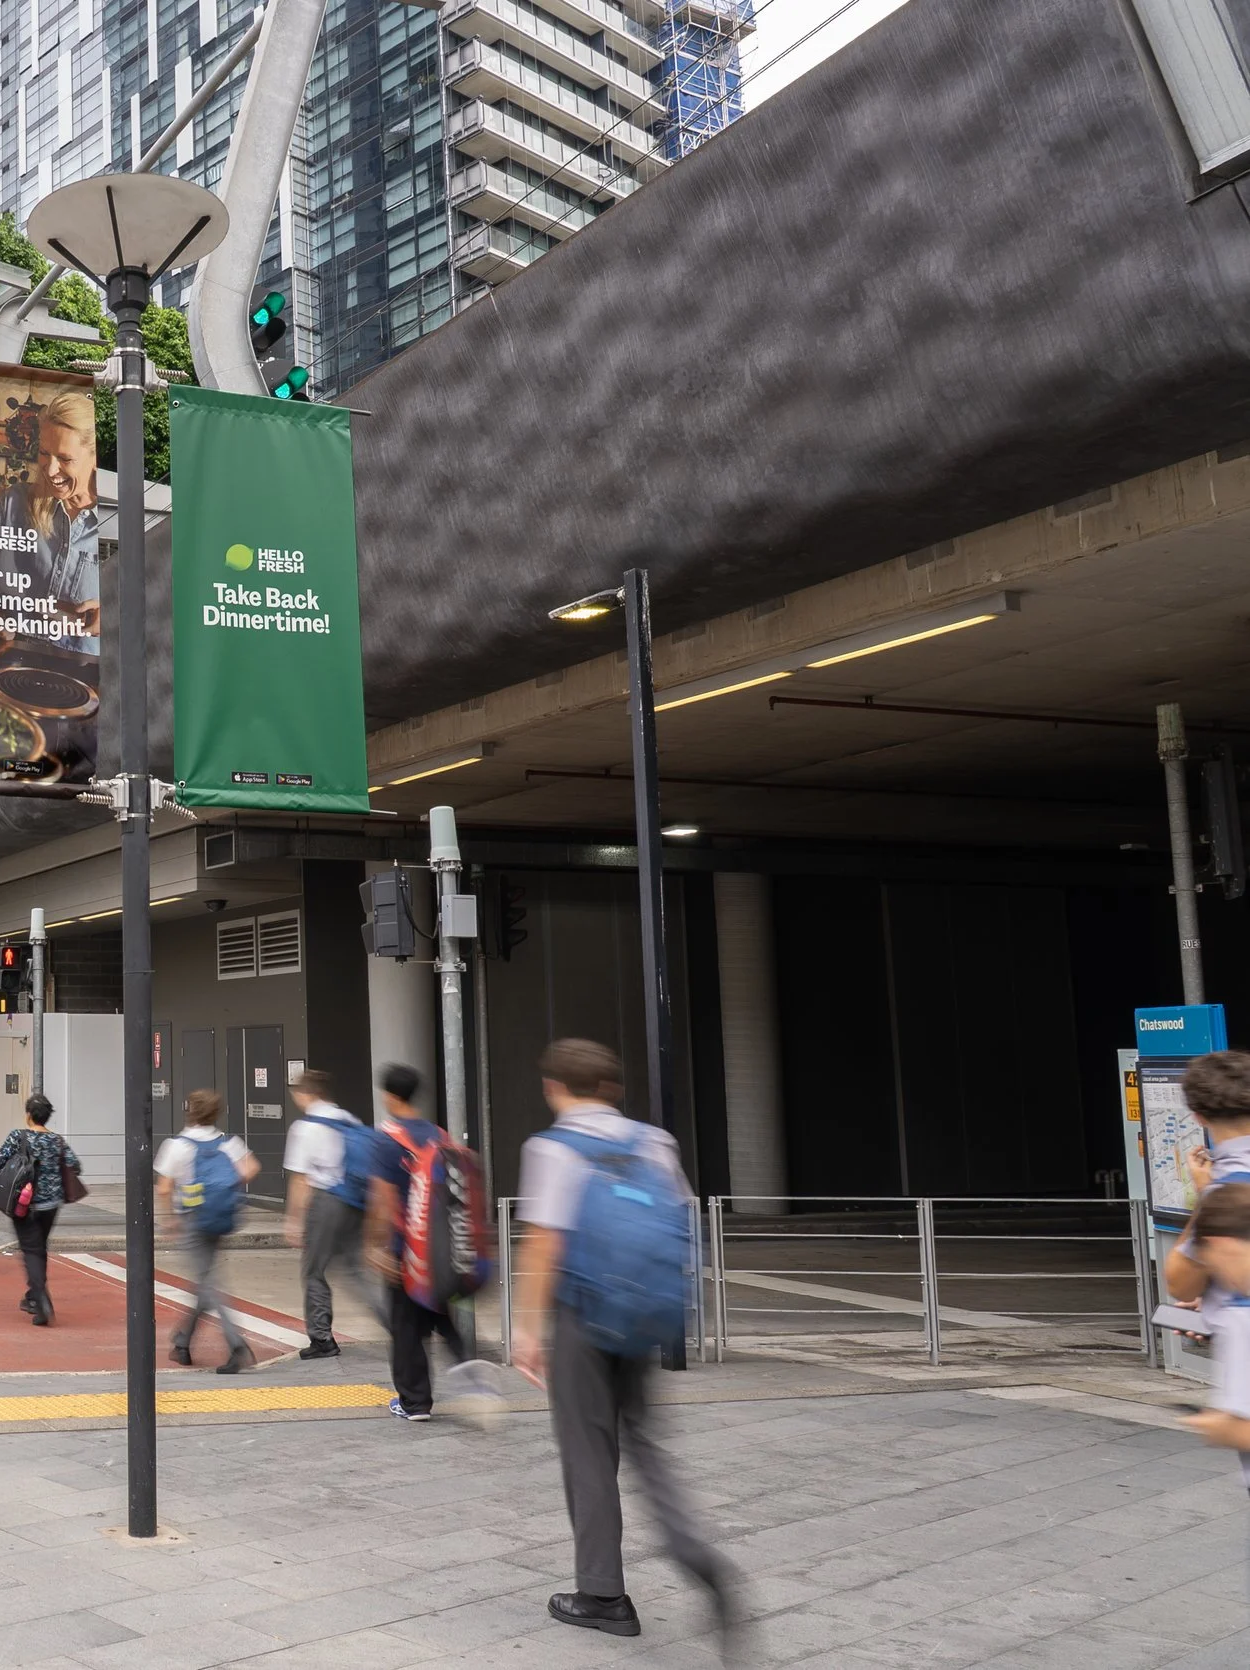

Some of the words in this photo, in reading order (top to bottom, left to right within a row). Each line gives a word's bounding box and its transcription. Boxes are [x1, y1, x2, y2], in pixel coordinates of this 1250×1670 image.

[258, 548, 304, 562] HELLO
[258, 560, 304, 573] FRESH
[5, 572, 31, 593] up
[213, 582, 262, 607] Take
[265, 587, 320, 610] Back
[203, 604, 330, 634] Dinnertime!
[1139, 1016, 1184, 1031] Chatswood
